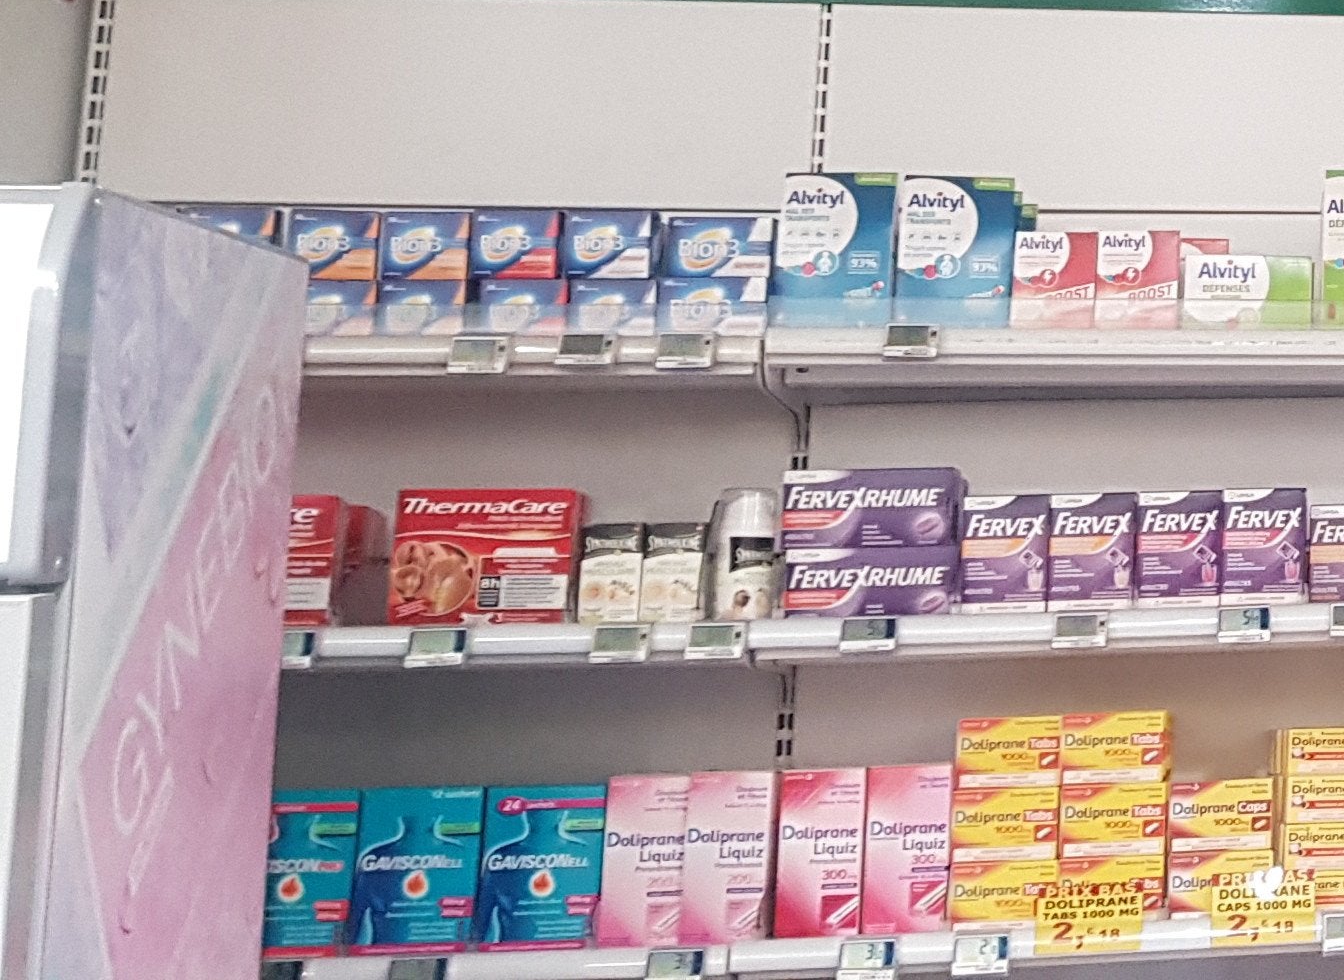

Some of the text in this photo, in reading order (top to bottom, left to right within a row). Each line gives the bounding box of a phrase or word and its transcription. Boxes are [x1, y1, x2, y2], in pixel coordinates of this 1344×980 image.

[787, 188, 844, 208] Alvityl
[908, 192, 965, 212] Alvityl
[1019, 235, 1064, 252] Alvityl
[1102, 234, 1147, 252] Alvityl
[1198, 260, 1257, 283] Alvityl
[404, 498, 568, 515] ThermaCare
[966, 514, 1047, 537] FERVEX
[1053, 512, 1131, 535] FERVEX
[1142, 509, 1219, 533] FERVEX
[1226, 506, 1301, 529] FERVEX
[961, 737, 1026, 752] Doliprane
[1064, 734, 1128, 748] Doliprane
[503, 799, 522, 812] 24
[1064, 806, 1129, 821] Doliprane
[1172, 801, 1236, 816] Doliprane
[956, 810, 1020, 825] Doliprane
[687, 828, 764, 845] Doliprane
[782, 825, 858, 841] Doliprane
[870, 821, 946, 838] Doliprane
[607, 832, 685, 848] Doliprane
[902, 838, 946, 853] Liquiz
[639, 849, 685, 864] Liquiz
[719, 846, 763, 862] Liquiz
[814, 841, 857, 857] Liquiz
[954, 884, 1020, 900] Doliprane
[1044, 896, 1138, 910] DOLIPRANE
[1216, 899, 1311, 912] CAPS 1000 MG
[1043, 908, 1139, 921] TABS 1000 MG
